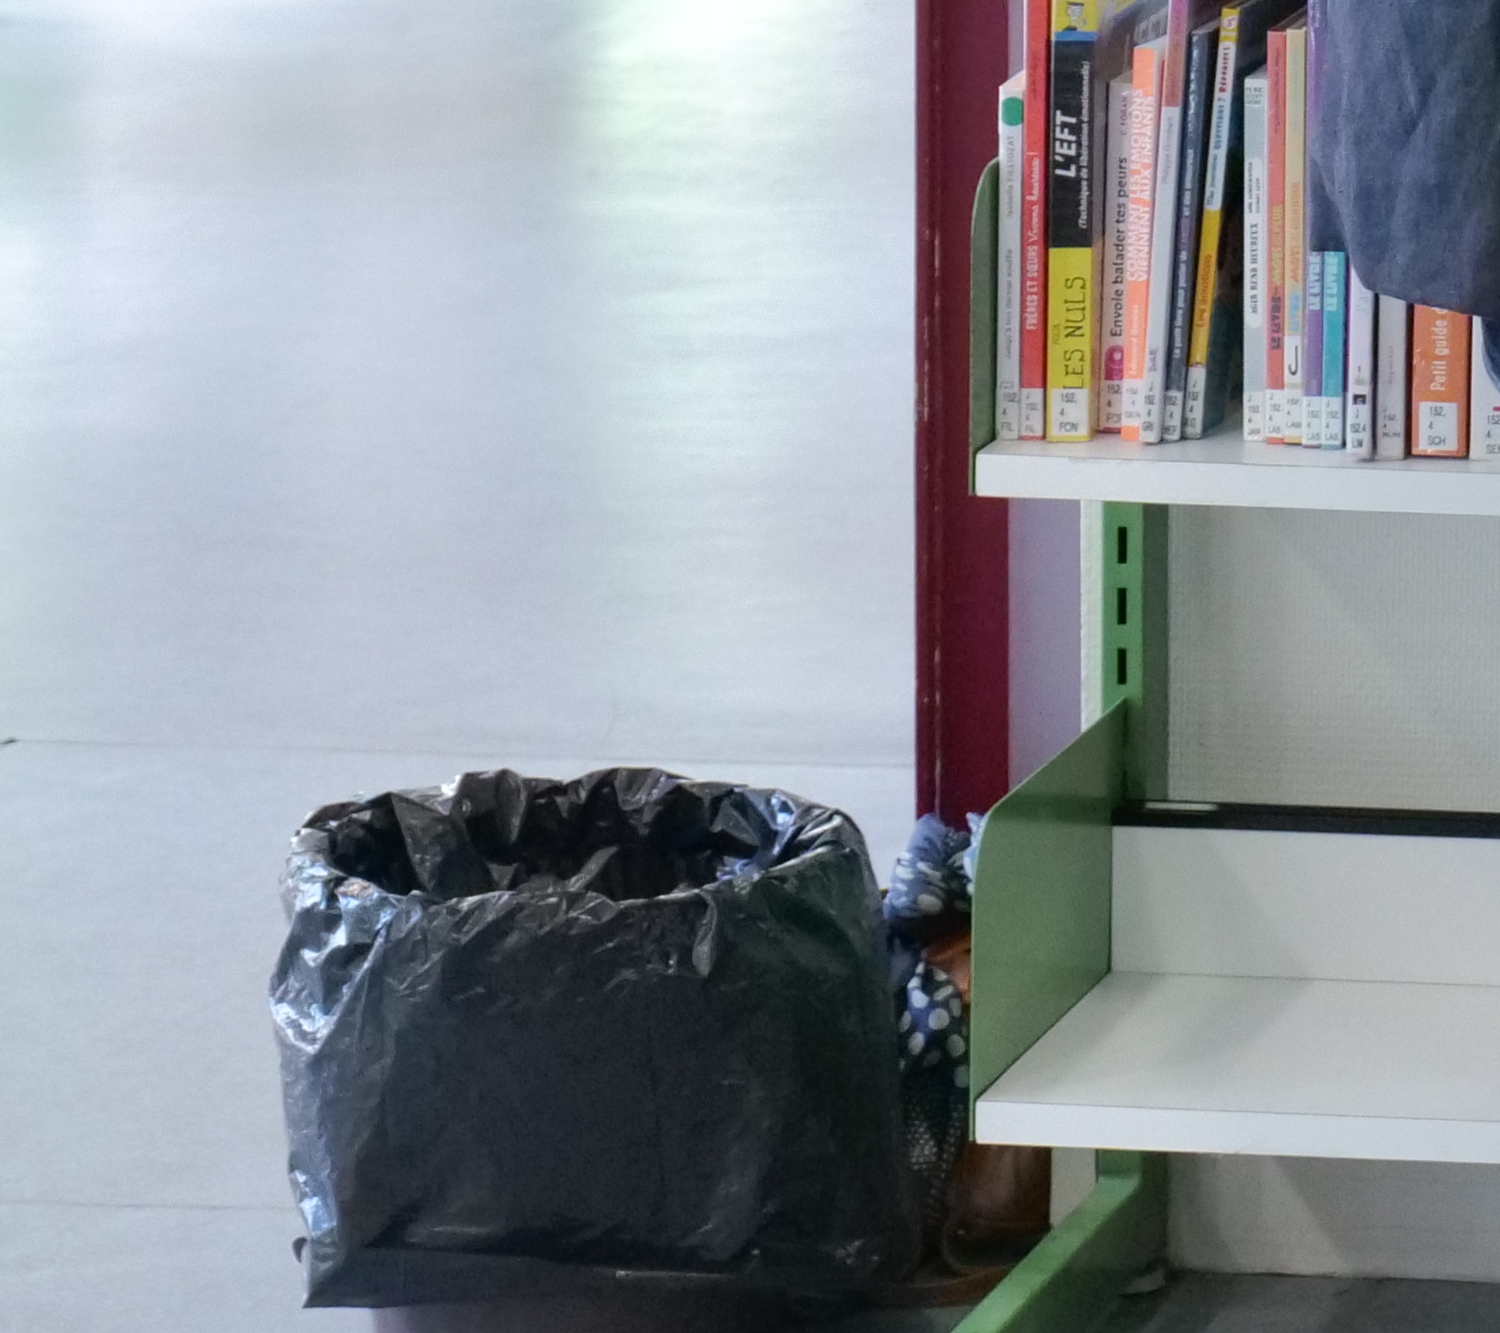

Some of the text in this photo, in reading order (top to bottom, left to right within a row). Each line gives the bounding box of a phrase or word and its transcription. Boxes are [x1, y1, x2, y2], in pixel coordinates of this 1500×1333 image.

[1054, 111, 1078, 179] L'EFT
[1063, 276, 1086, 389] LES NULS
